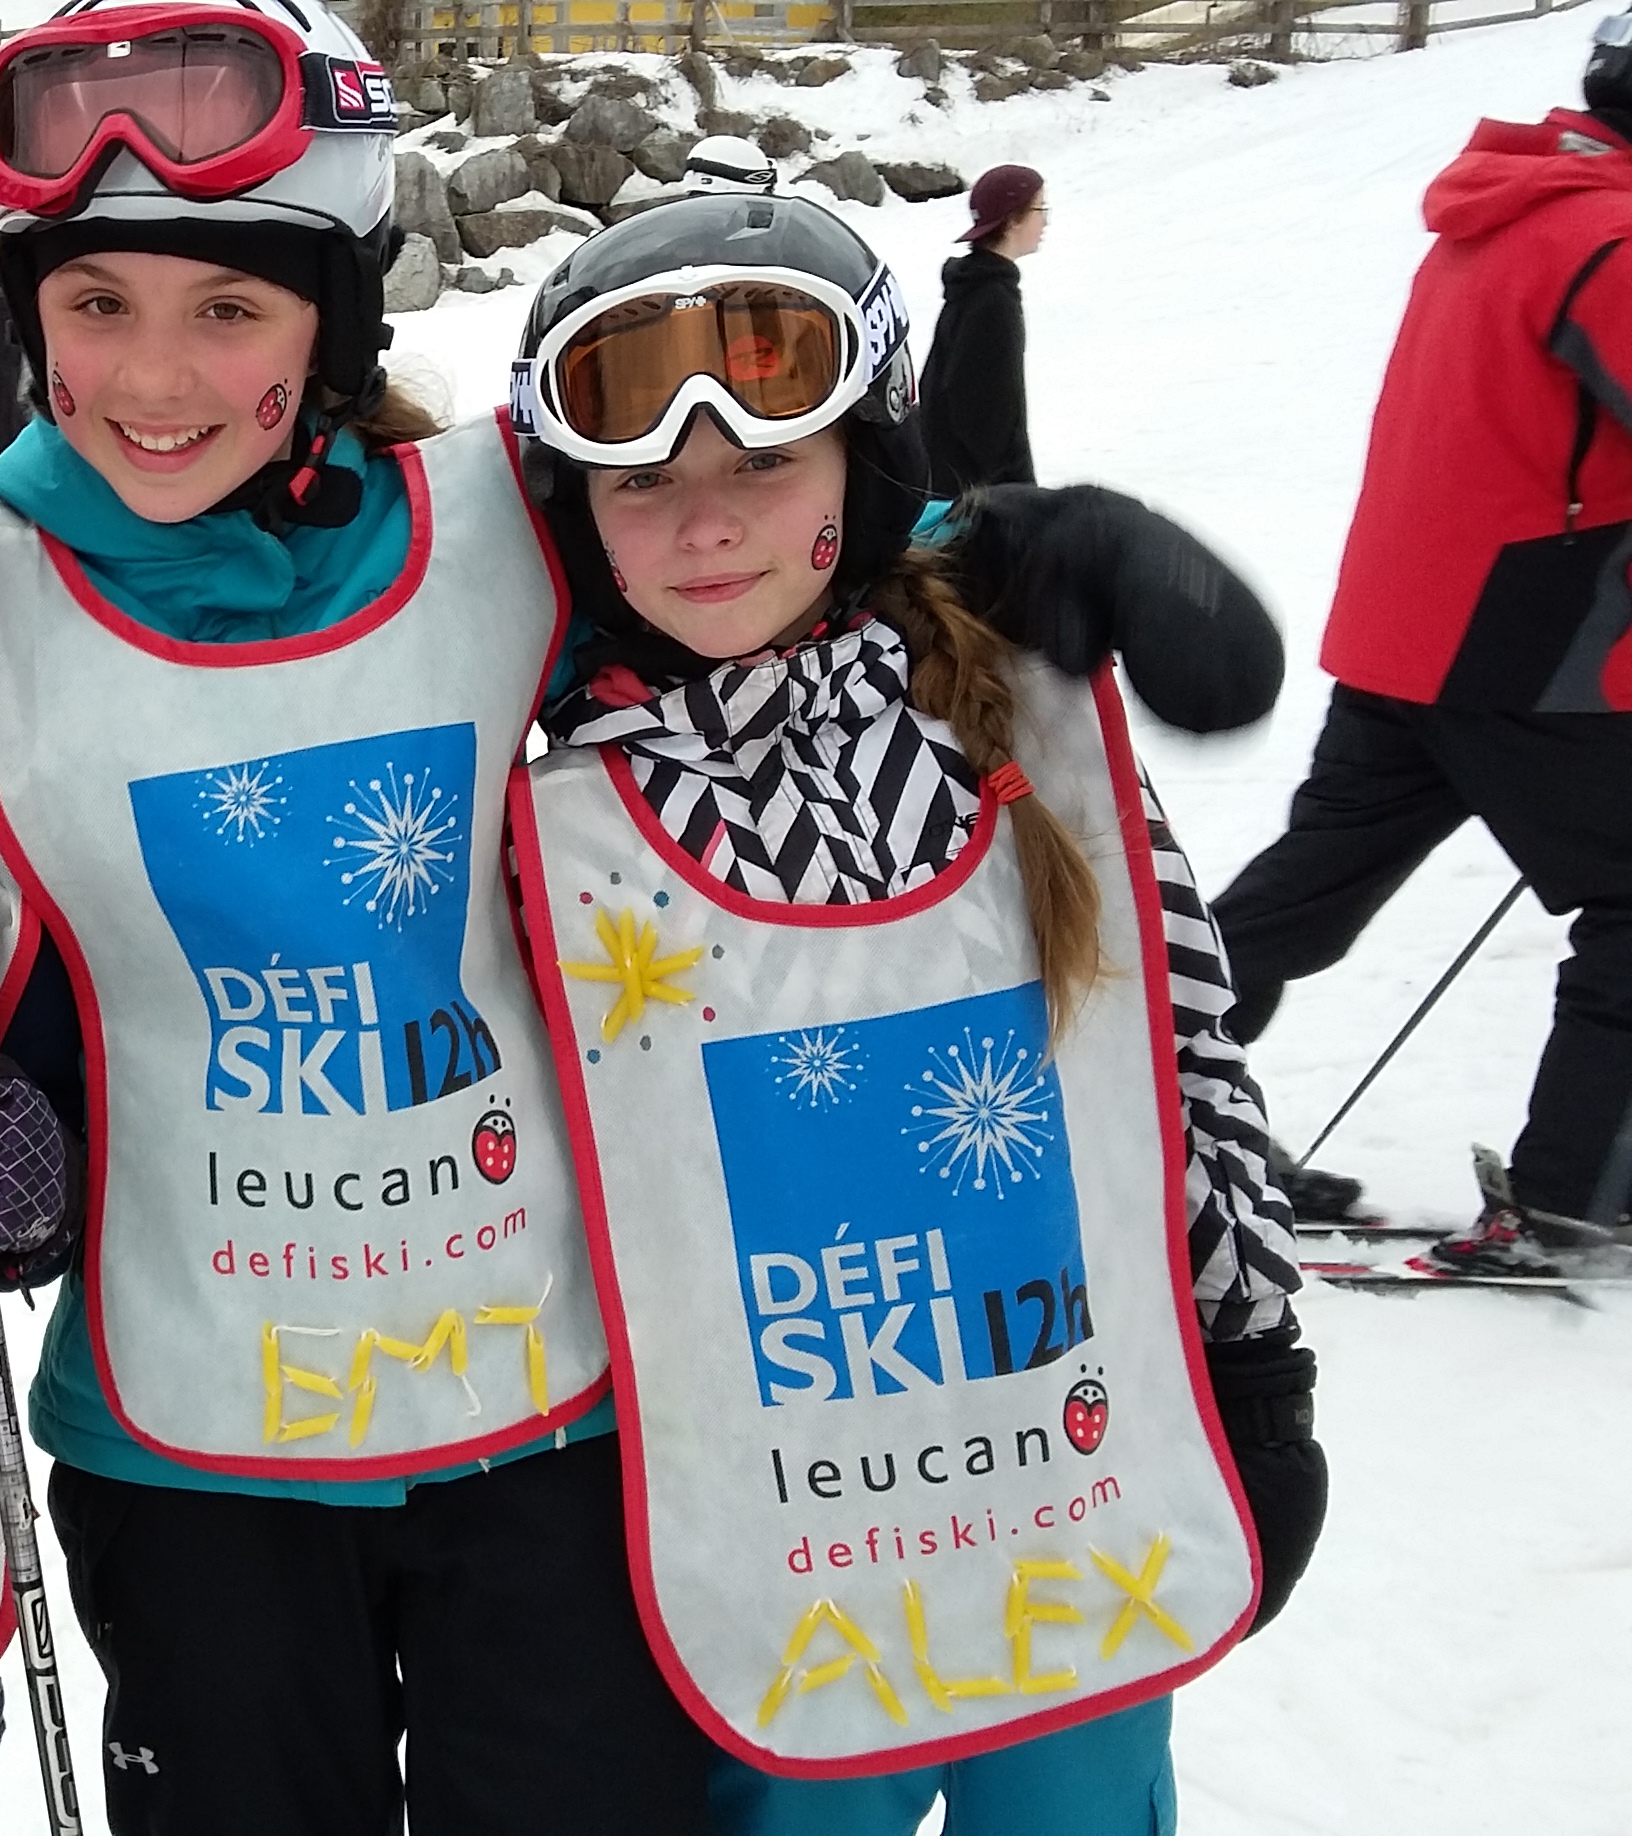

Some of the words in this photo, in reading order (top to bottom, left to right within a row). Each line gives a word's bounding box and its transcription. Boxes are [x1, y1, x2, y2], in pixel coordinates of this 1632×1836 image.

[204, 953, 378, 1025] DÉFI
[213, 1026, 389, 1116] SKI
[404, 1000, 502, 1107] 12h
[212, 1207, 526, 1281] defiski.com
[749, 1223, 953, 1316] DÉFI
[758, 1296, 970, 1407] SKI
[983, 1266, 1096, 1377] 12h
[787, 1476, 1122, 1574] defiski.com
[757, 1530, 1195, 1728] ALEX
